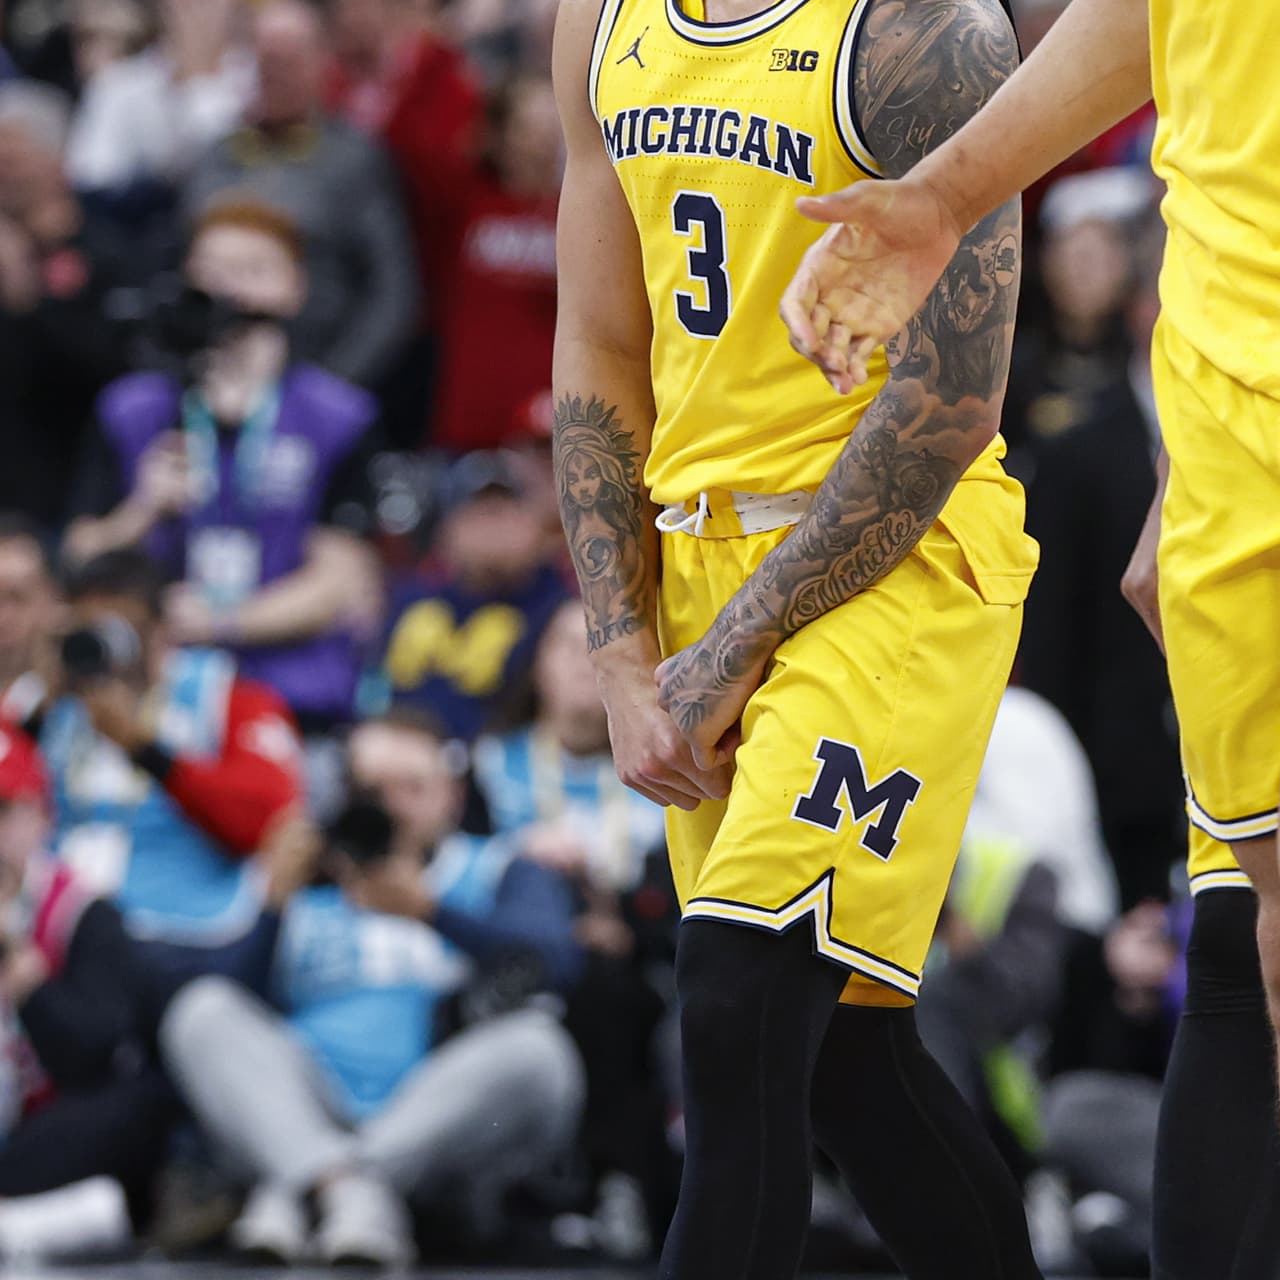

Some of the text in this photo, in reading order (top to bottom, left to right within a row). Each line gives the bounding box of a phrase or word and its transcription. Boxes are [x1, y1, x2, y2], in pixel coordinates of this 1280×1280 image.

[601, 105, 817, 188] MICHIGAN
[672, 189, 733, 340] 3
[791, 736, 924, 863] M
